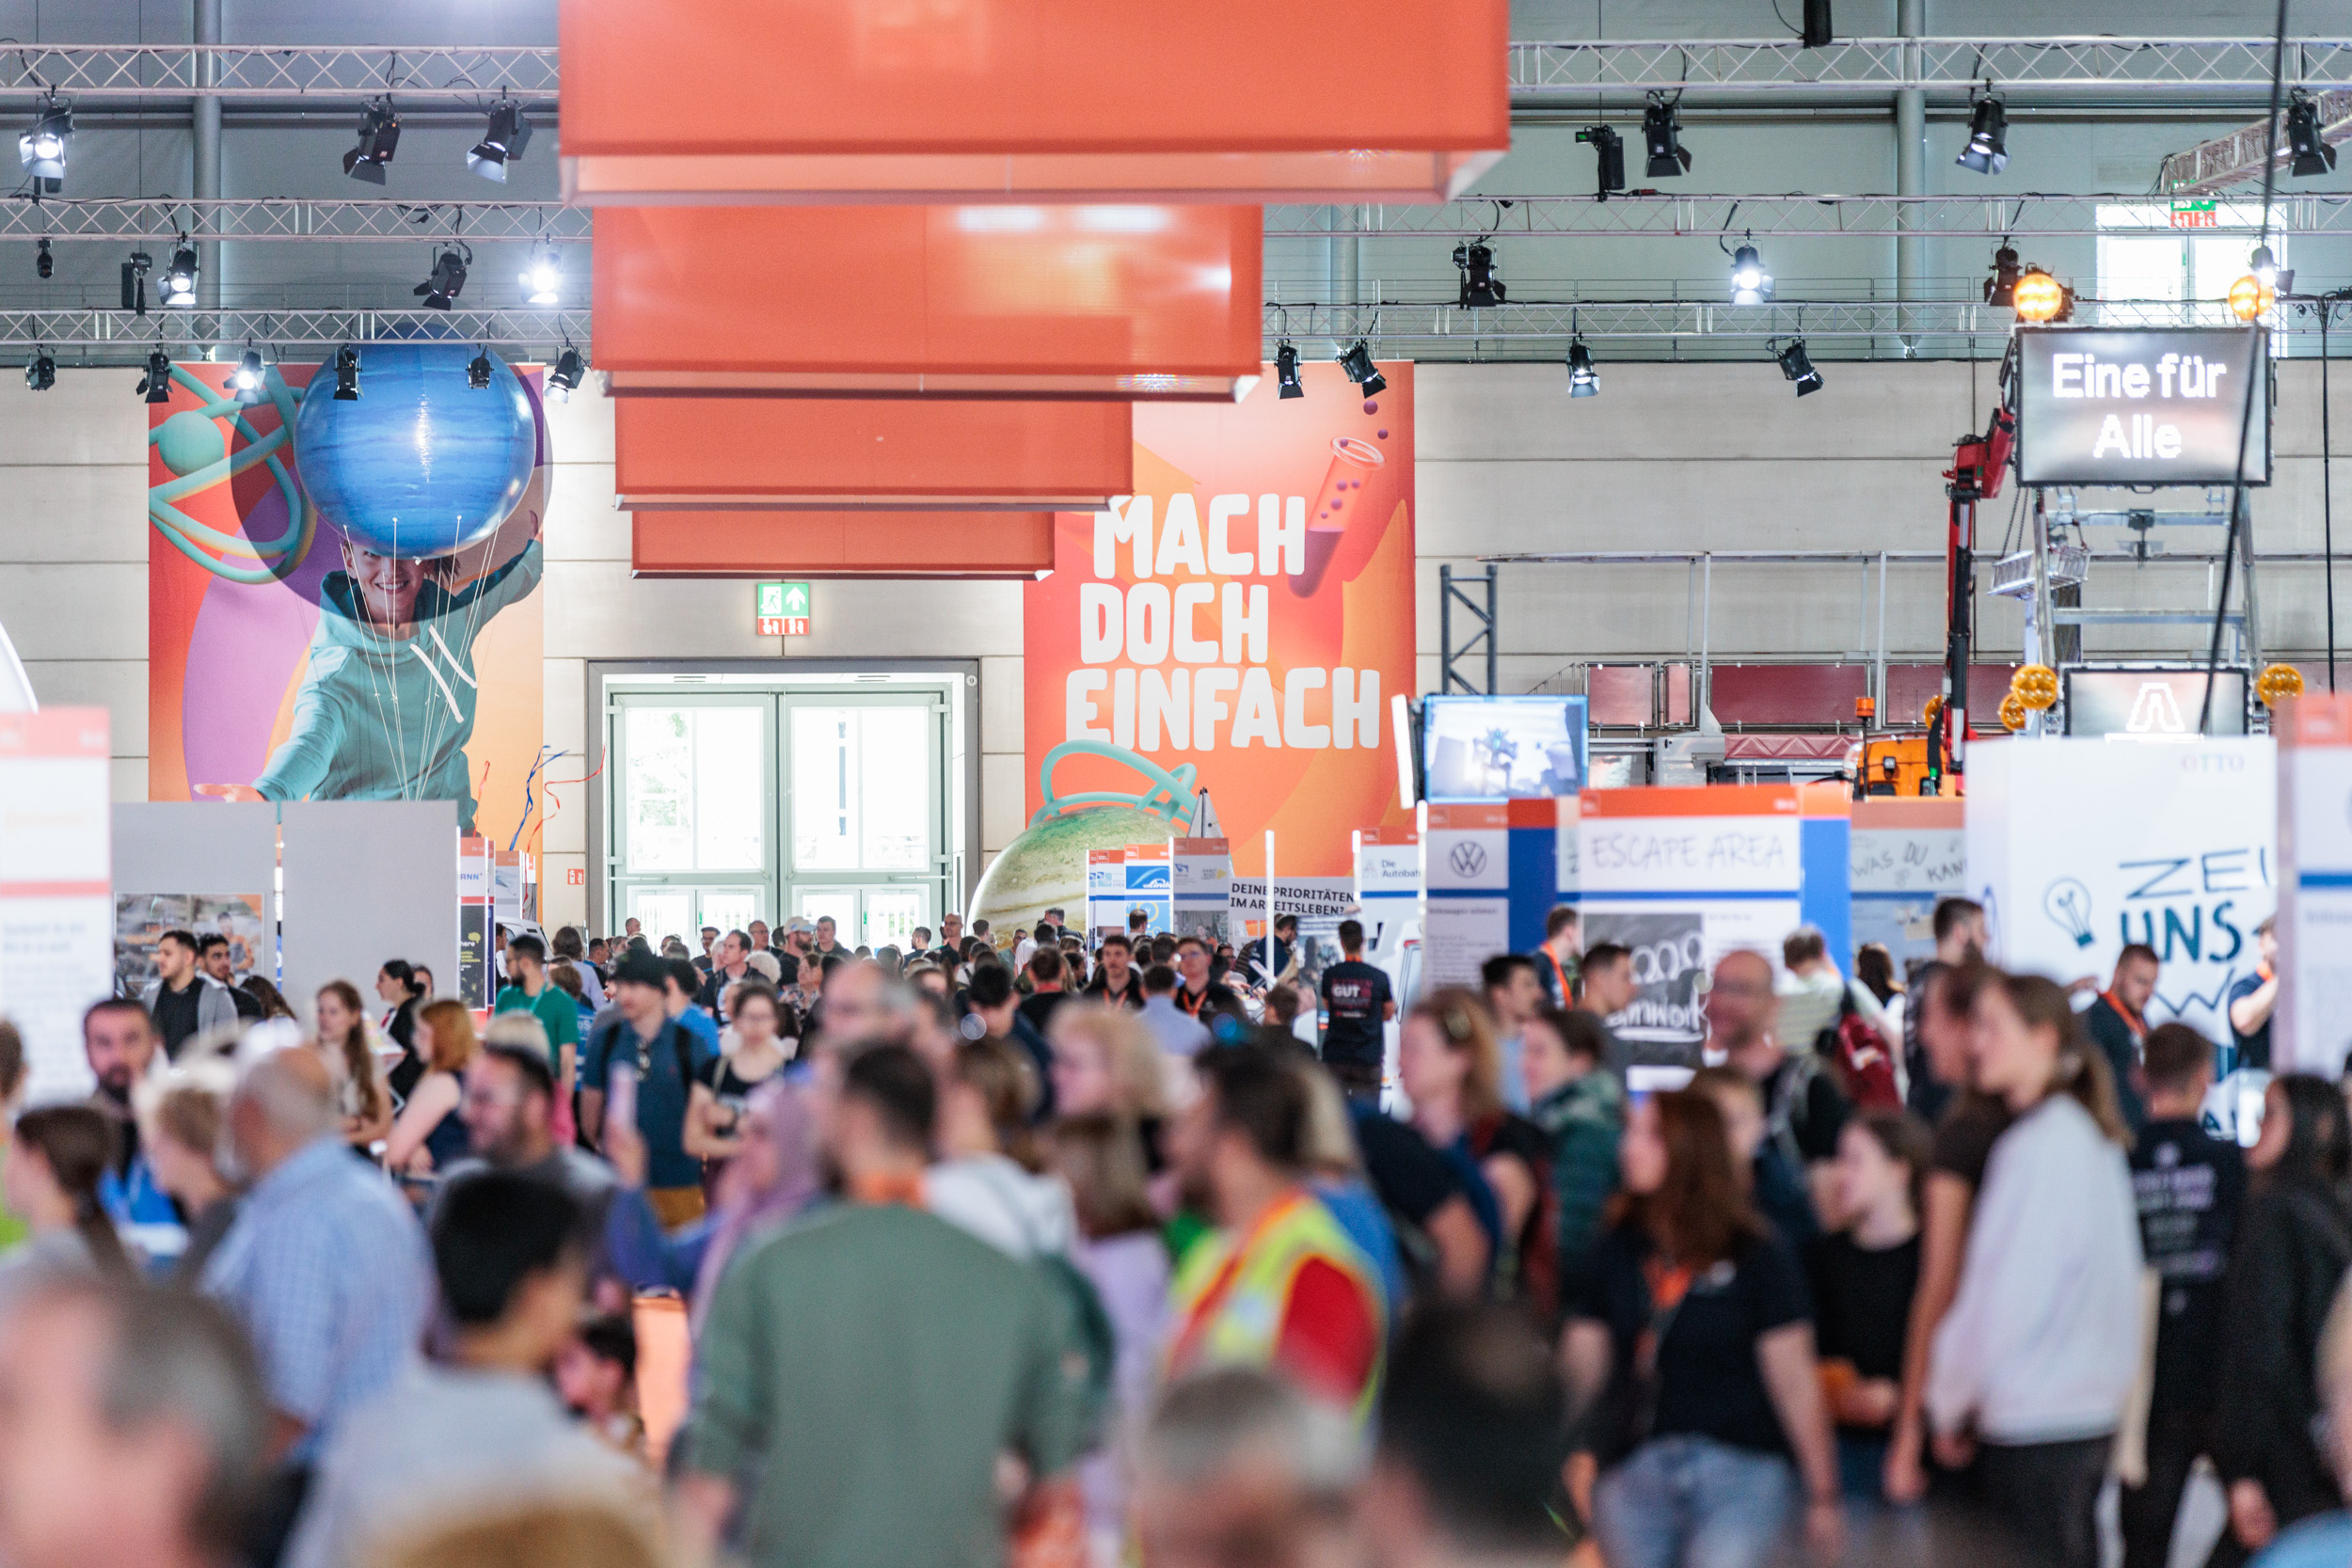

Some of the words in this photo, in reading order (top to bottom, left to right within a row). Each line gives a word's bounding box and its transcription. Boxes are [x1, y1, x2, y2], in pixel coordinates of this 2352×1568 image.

[2051, 352, 2151, 399] Eine
[2156, 352, 2227, 399] für
[2092, 414, 2183, 459] Alle
[1092, 492, 1306, 579] MACH
[1078, 581, 1269, 665] DOCH
[1065, 666, 1381, 752] EINFACH
[2180, 753, 2245, 771] OTTO
[1381, 860, 1397, 868] Die
[1591, 832, 1698, 869] ESCAPE
[1706, 832, 1786, 870] AREA
[1903, 839, 1929, 866] DU
[1927, 858, 1967, 883] KAN
[2118, 847, 2271, 899] ZEI
[1232, 882, 1267, 895] DEINE
[1274, 887, 1355, 903] PRIORITÄTEN
[1381, 869, 1421, 879] Autobah
[1230, 897, 1248, 909] IM
[1249, 900, 1345, 915] AREITSLEBEN?
[2120, 900, 2244, 965] UNS
[1331, 985, 1360, 998] GUT
